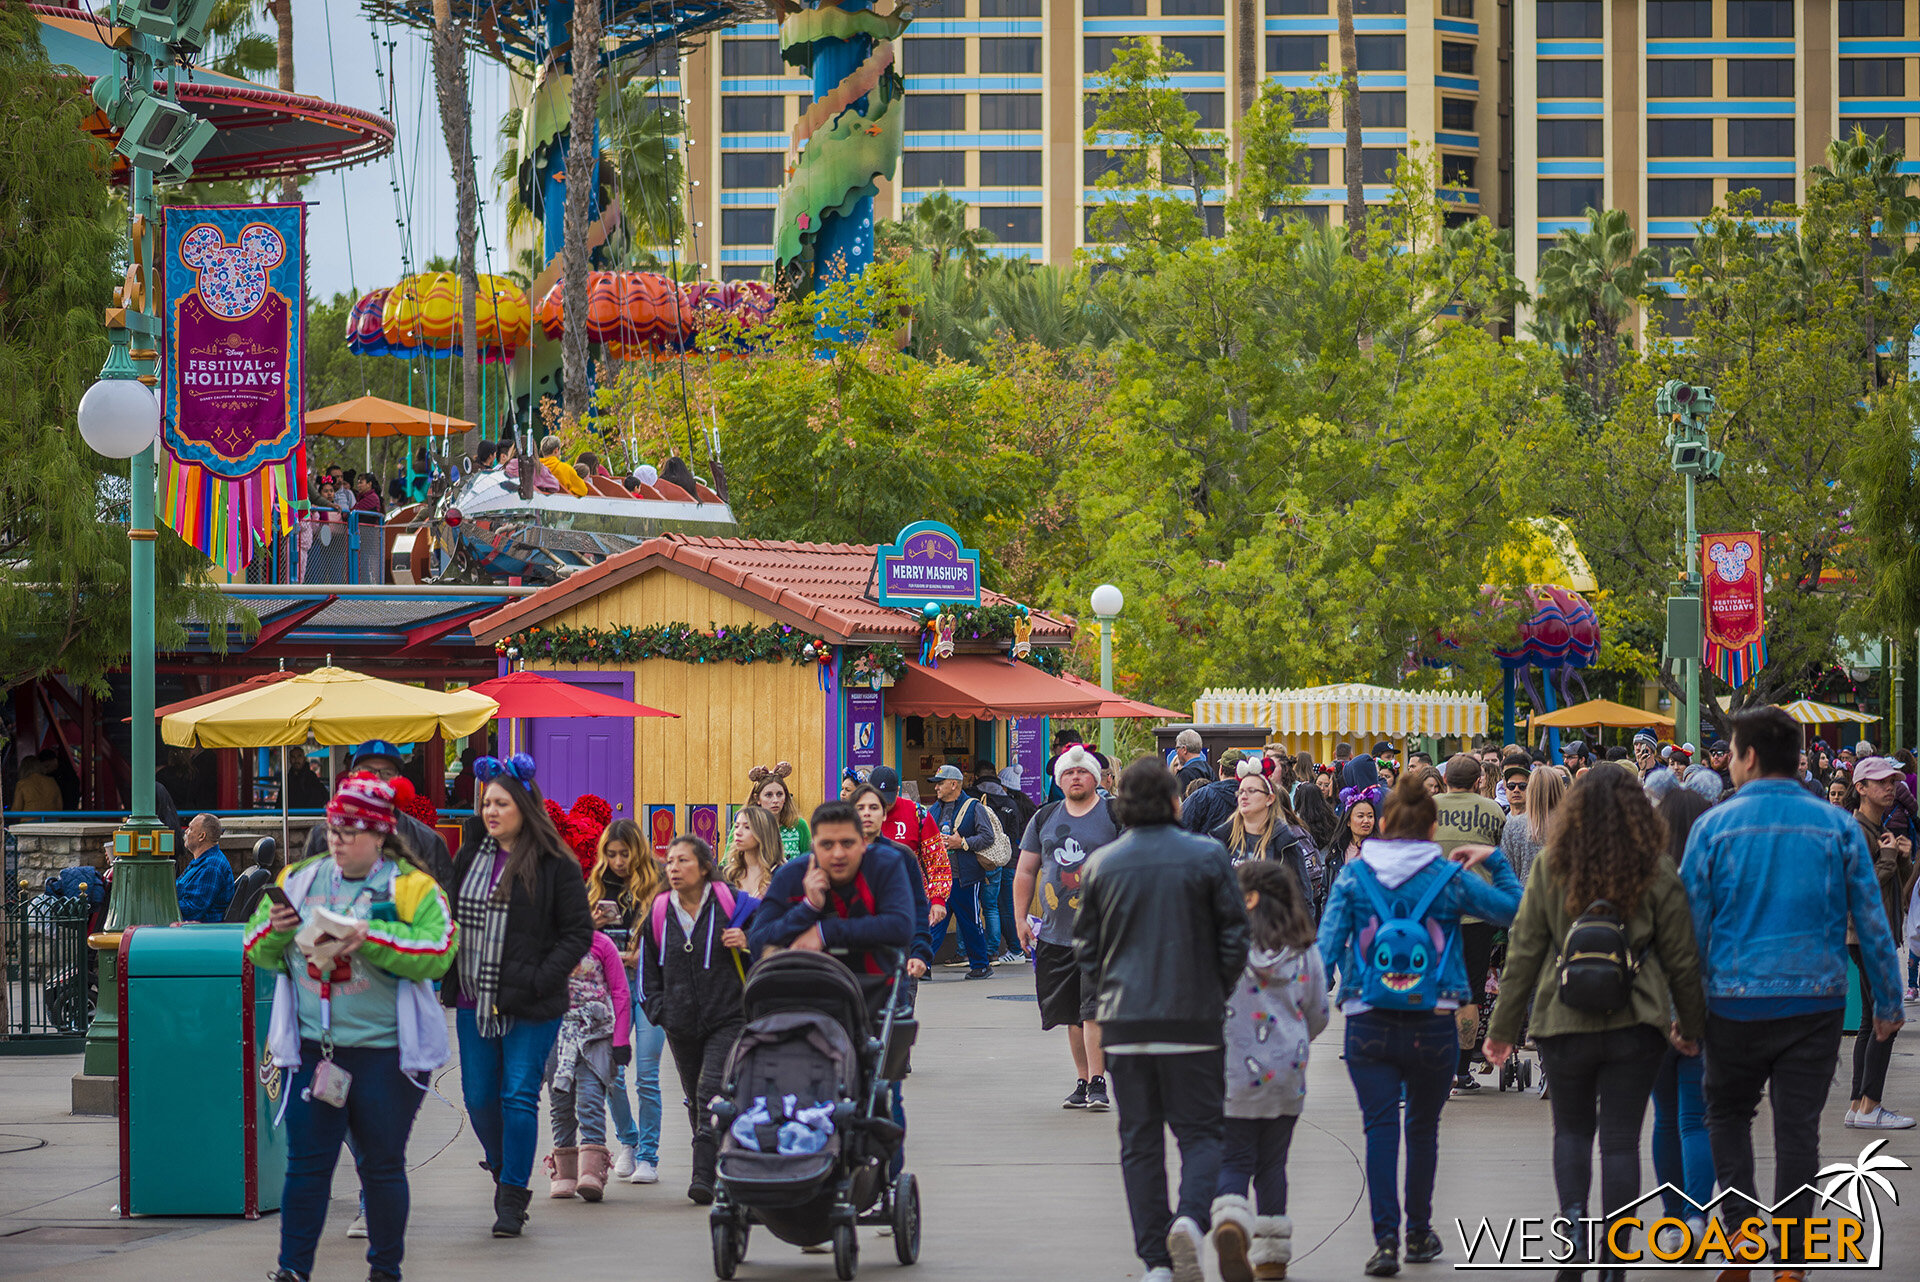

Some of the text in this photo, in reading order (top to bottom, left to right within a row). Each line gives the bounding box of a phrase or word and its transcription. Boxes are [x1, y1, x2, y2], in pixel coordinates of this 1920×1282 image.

[224, 348, 244, 357] Disney
[189, 360, 262, 371] FESTIVAL
[184, 372, 281, 386] HOLIDAYS
[892, 564, 968, 581] MERRY MASHUPS
[1712, 603, 1754, 612] HOLIDAYS
